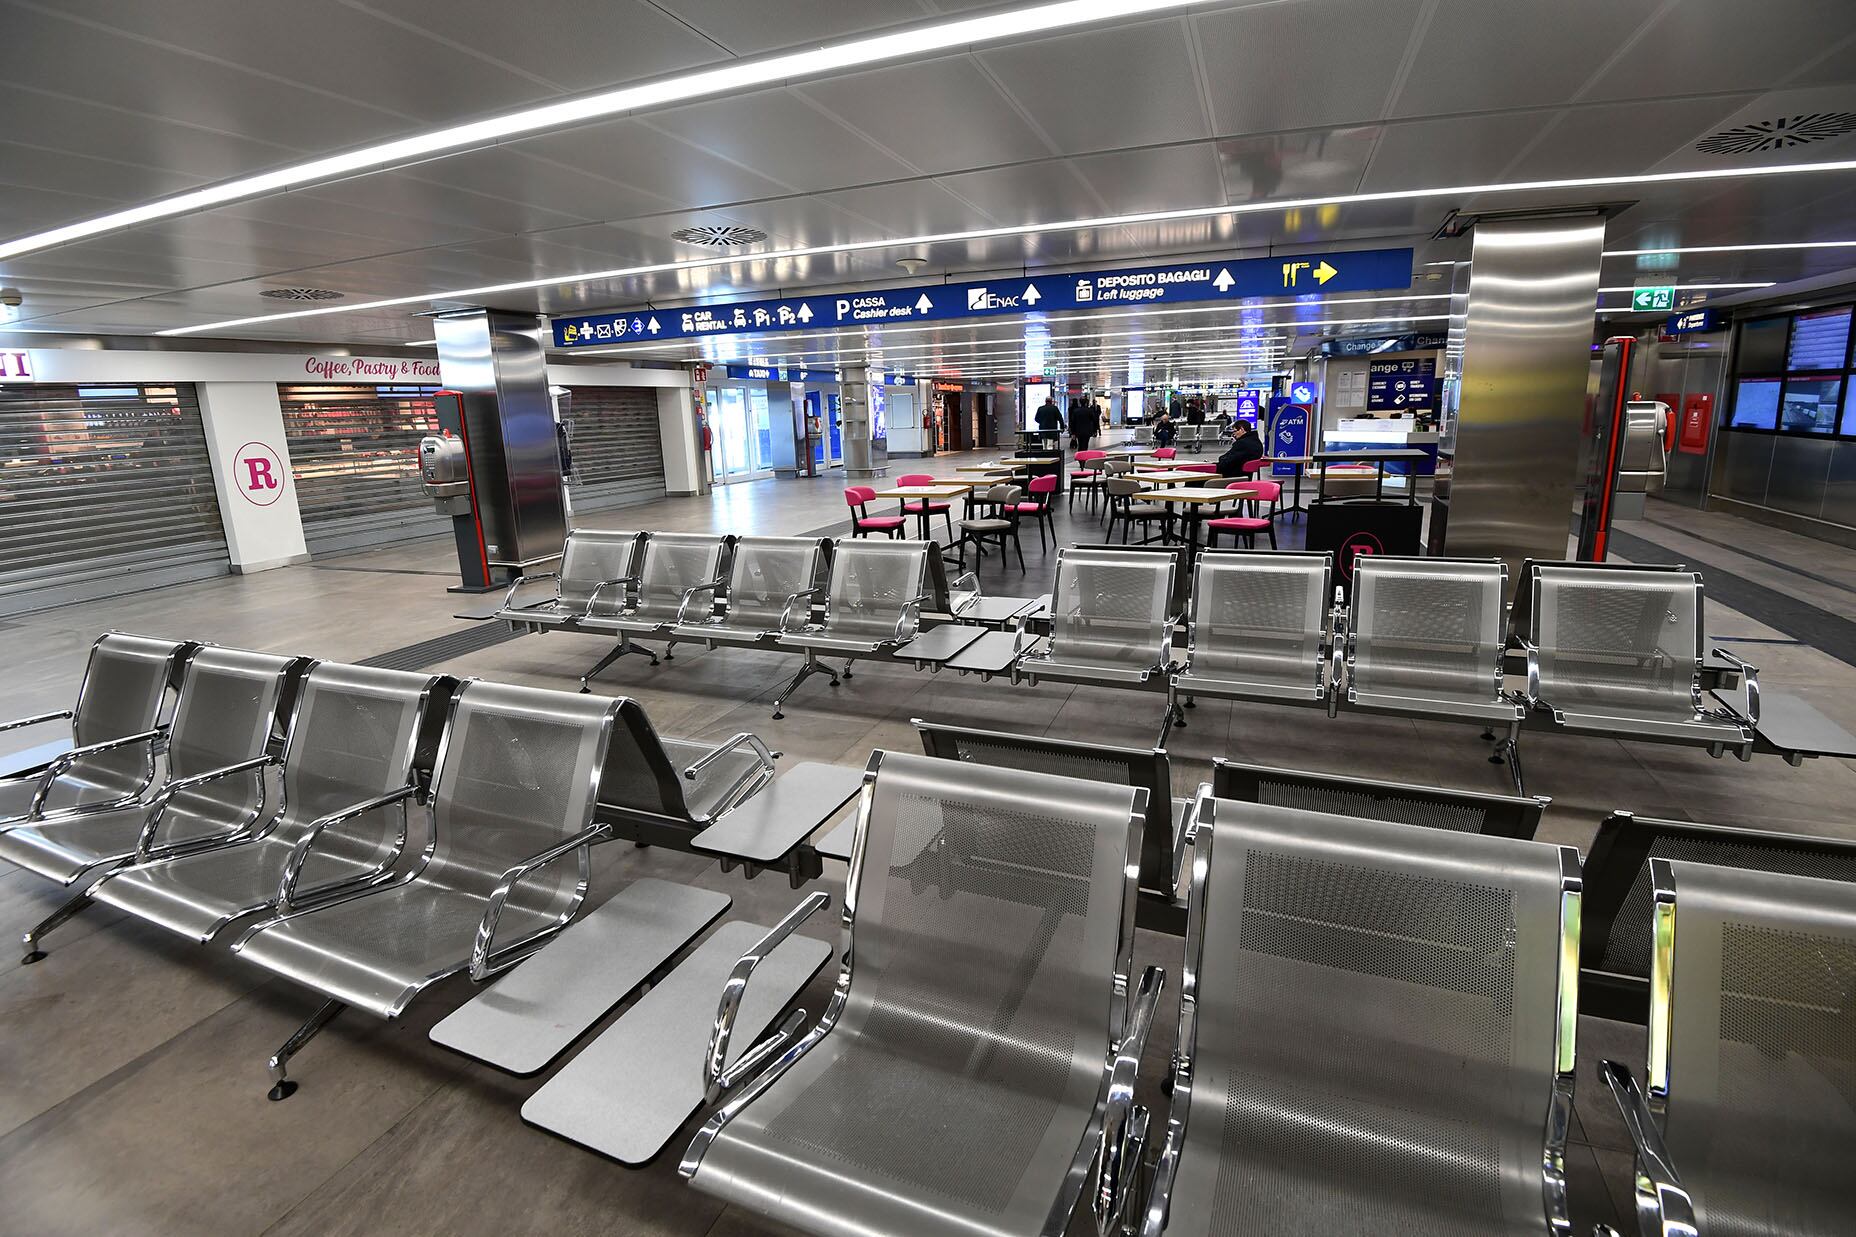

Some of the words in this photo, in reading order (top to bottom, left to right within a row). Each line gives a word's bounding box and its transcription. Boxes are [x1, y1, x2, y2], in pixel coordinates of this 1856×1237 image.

[1097, 273, 1156, 288] DEPOSITO
[1157, 269, 1210, 283] BAGAGLI
[1096, 289, 1118, 300] Left
[1119, 288, 1164, 300] luggage
[852, 297, 886, 308] CASSA
[836, 299, 850, 320] P
[853, 308, 889, 319] Cashier
[889, 306, 912, 317] desk
[694, 311, 712, 321] CAR
[695, 320, 728, 331] RENTAL
[1346, 342, 1376, 351] Change
[1417, 336, 1448, 346] Chan
[0, 353, 30, 376] I
[305, 357, 352, 379] Coffee,
[352, 358, 399, 380] Pastry
[400, 361, 410, 374] &
[411, 361, 440, 376] Food
[243, 457, 278, 490] R
